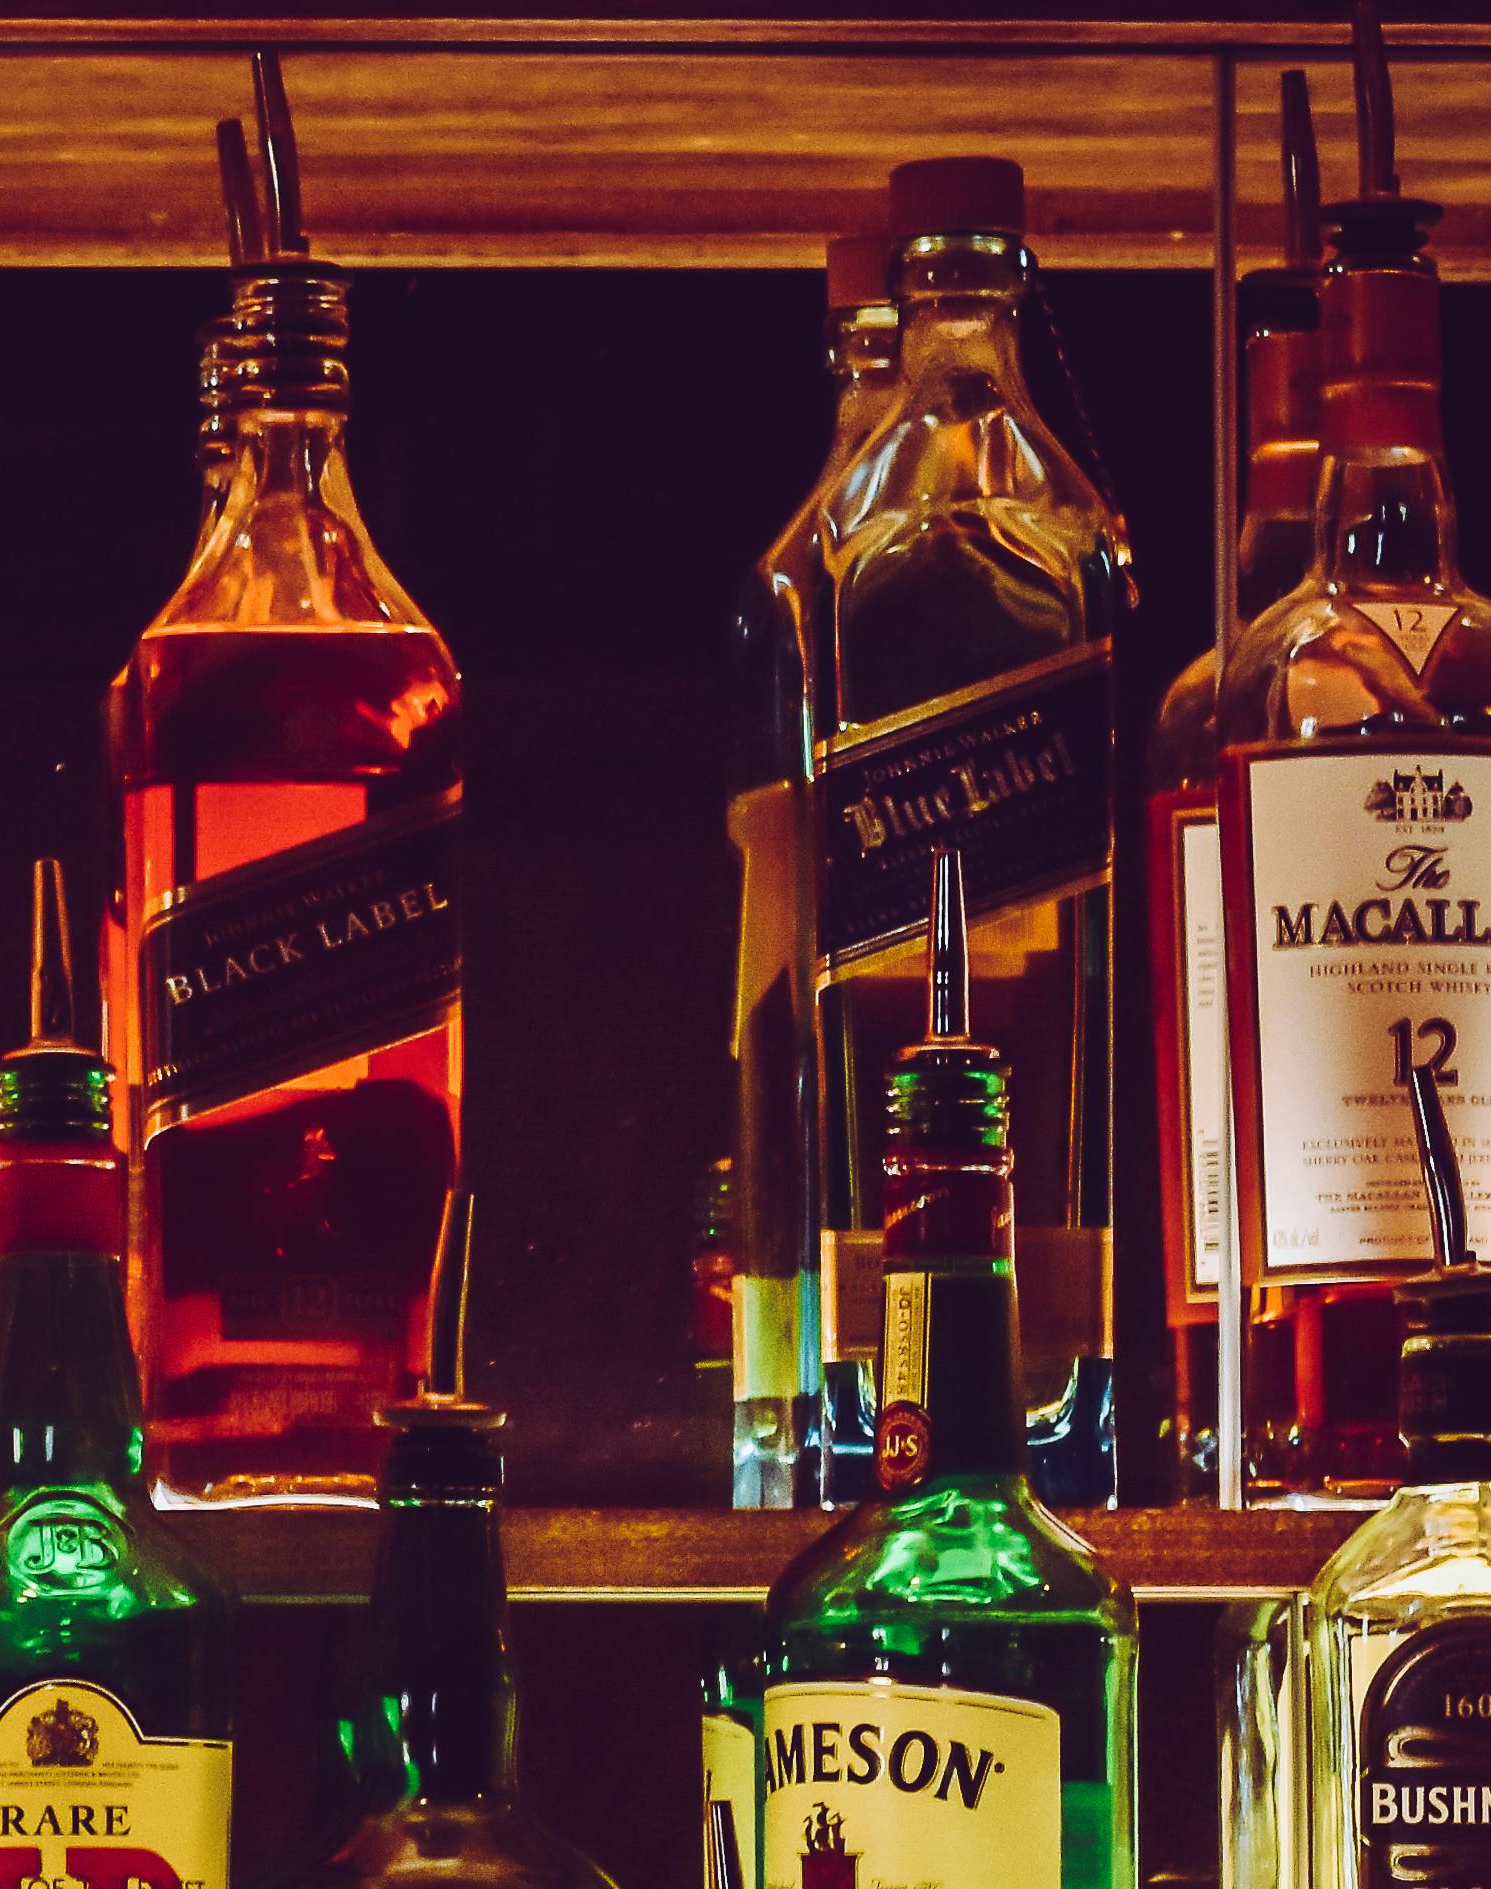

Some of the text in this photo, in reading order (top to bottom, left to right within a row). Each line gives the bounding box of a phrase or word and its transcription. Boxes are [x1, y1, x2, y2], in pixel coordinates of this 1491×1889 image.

[1377, 844, 1451, 892] The
[165, 881, 450, 1006] BLACK LABEL
[1309, 962, 1478, 978] HIGHLAND SINGLE
[1347, 980, 1491, 994] SCOTCH WHISKY
[1387, 1016, 1459, 1087] 12
[0, 1805, 131, 1837] RARE
